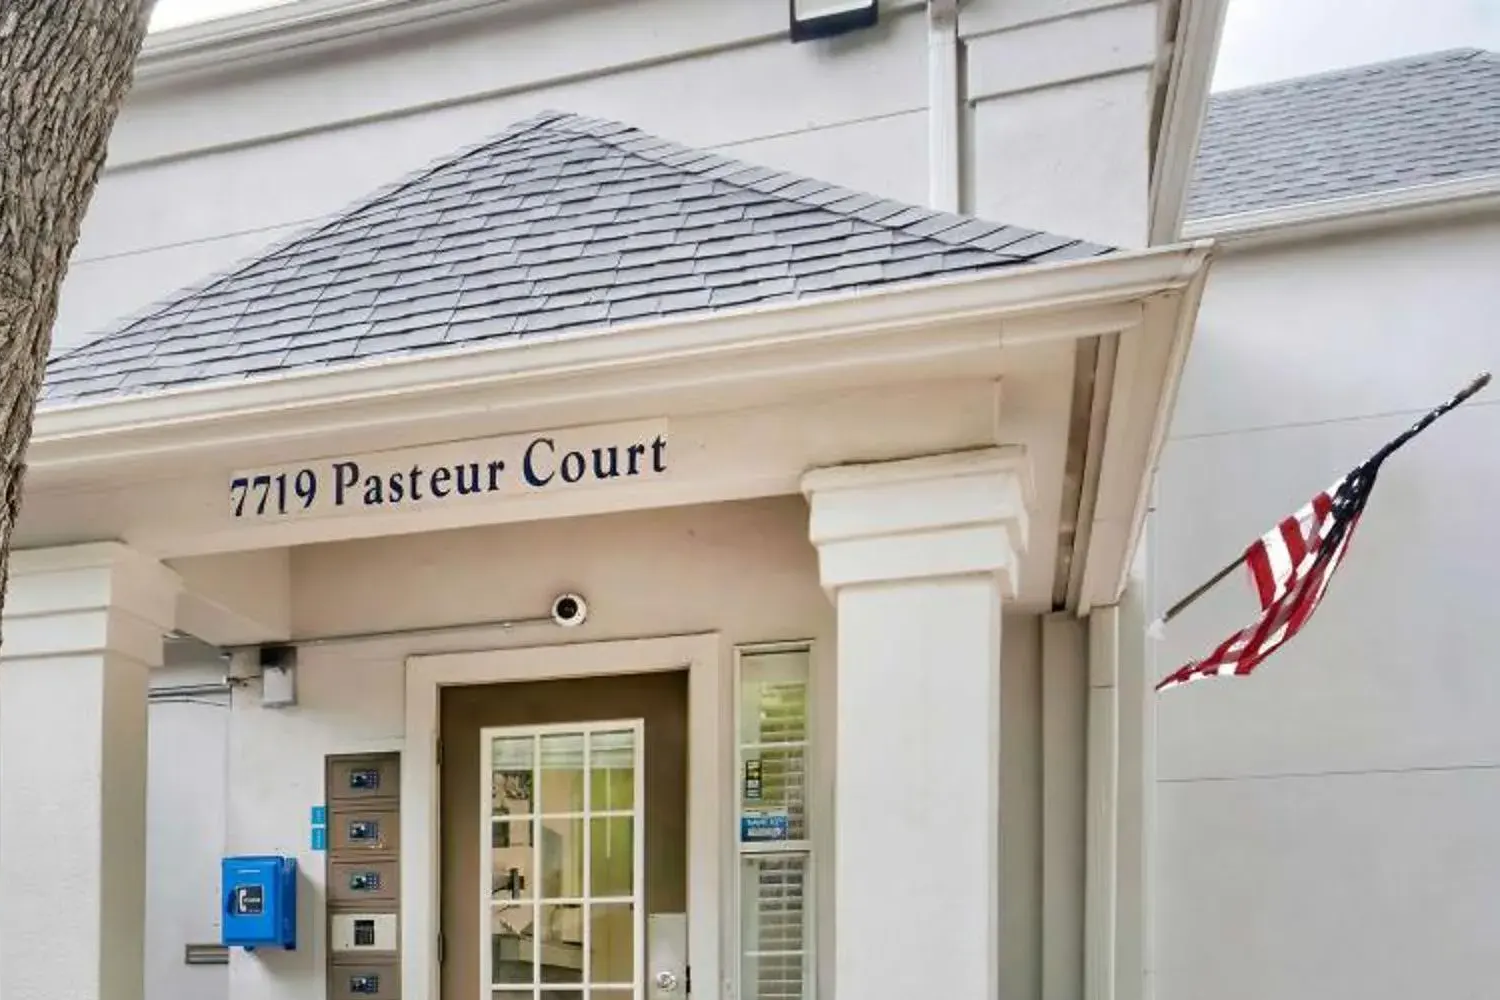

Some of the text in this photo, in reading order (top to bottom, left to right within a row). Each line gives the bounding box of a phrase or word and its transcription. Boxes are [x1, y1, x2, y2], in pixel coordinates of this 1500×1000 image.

[230, 435, 668, 518] 7719 Pasteur Court
